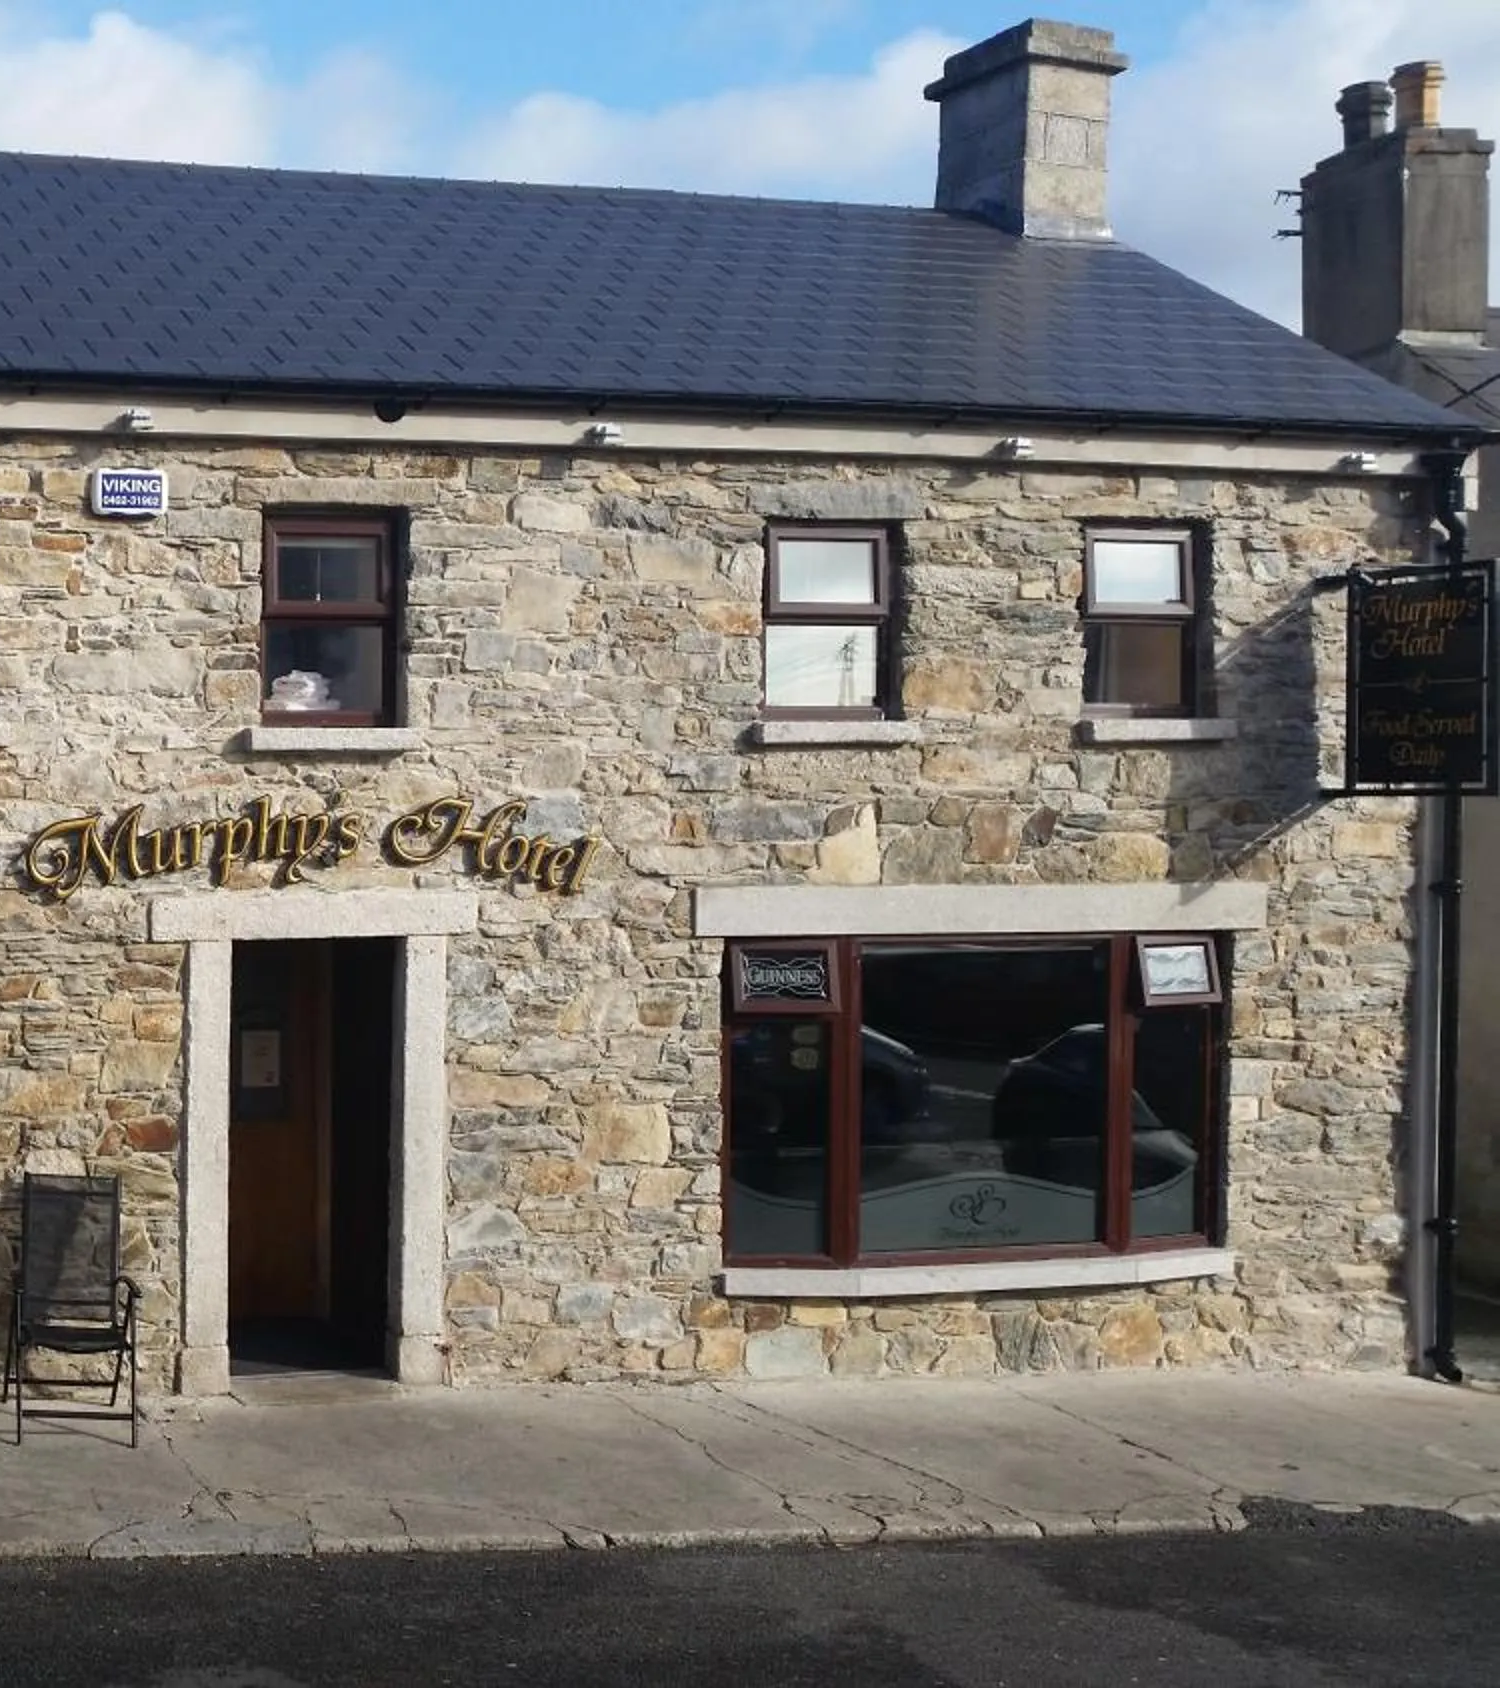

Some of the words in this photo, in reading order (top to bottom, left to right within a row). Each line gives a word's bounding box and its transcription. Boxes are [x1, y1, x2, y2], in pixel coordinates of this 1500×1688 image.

[103, 478, 161, 493] VIKING
[1371, 627, 1445, 659] Hotel
[390, 795, 599, 895] Hotel
[747, 966, 821, 985] GUINNESS
